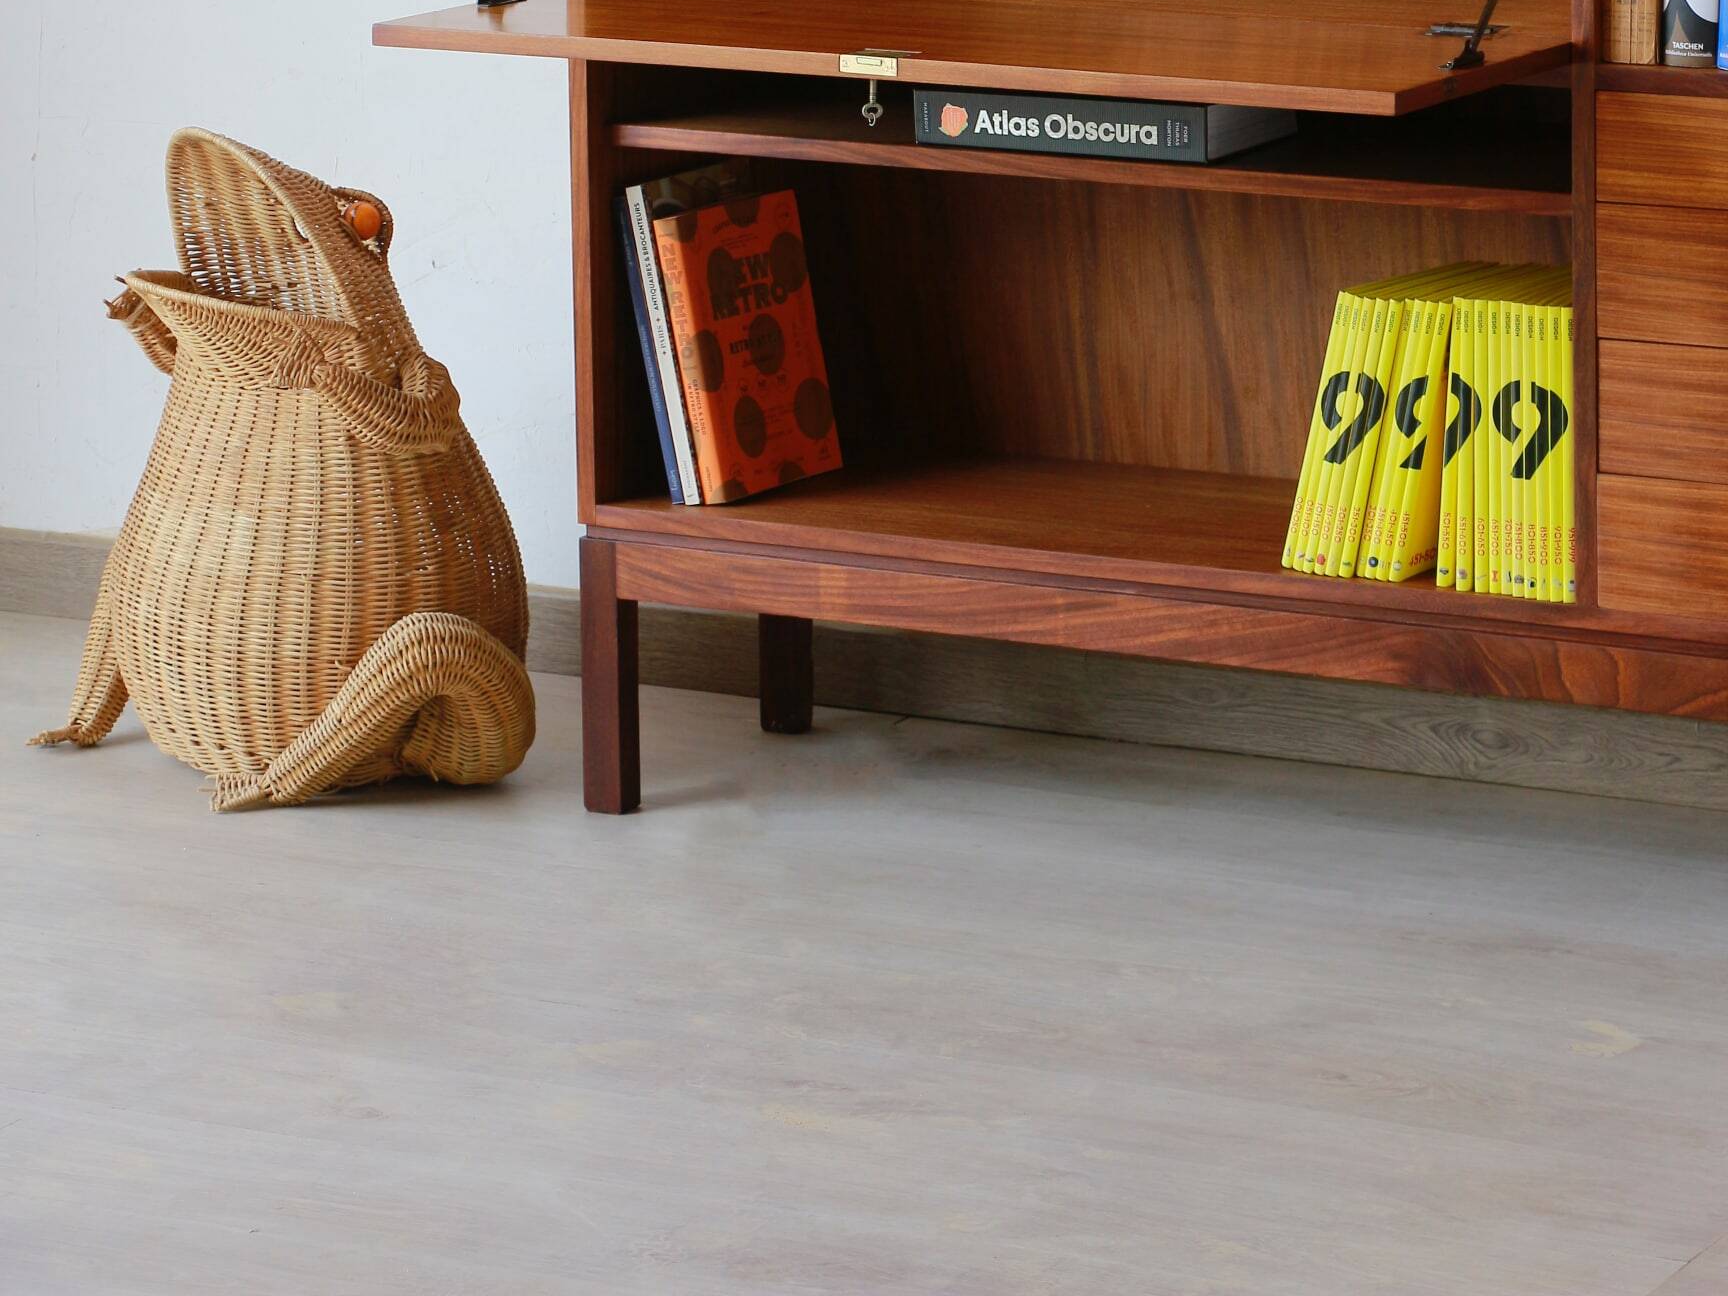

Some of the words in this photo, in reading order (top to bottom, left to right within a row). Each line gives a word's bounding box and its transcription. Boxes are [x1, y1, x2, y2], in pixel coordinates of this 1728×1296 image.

[1672, 41, 1704, 51] TASCHEN
[973, 109, 1040, 138] Atlas
[1044, 113, 1158, 146] Obscura
[634, 202, 649, 256] BROCANTEURS
[662, 244, 683, 285] NEW
[645, 262, 659, 311] ANTIQUAIRES
[671, 291, 694, 359] RETRO
[1311, 503, 1323, 535] 101-150
[1334, 506, 1347, 543] 201-250
[1348, 506, 1360, 543] 251-300
[1442, 512, 1451, 550] 501-550
[1459, 516, 1467, 555] 551-600
[1477, 518, 1485, 557] 601-650
[1491, 519, 1499, 556] 651-700
[1504, 519, 1512, 555] 701-750
[1528, 524, 1536, 564] 801-850
[1540, 526, 1548, 566] 851-900
[1554, 526, 1562, 565] 901-950
